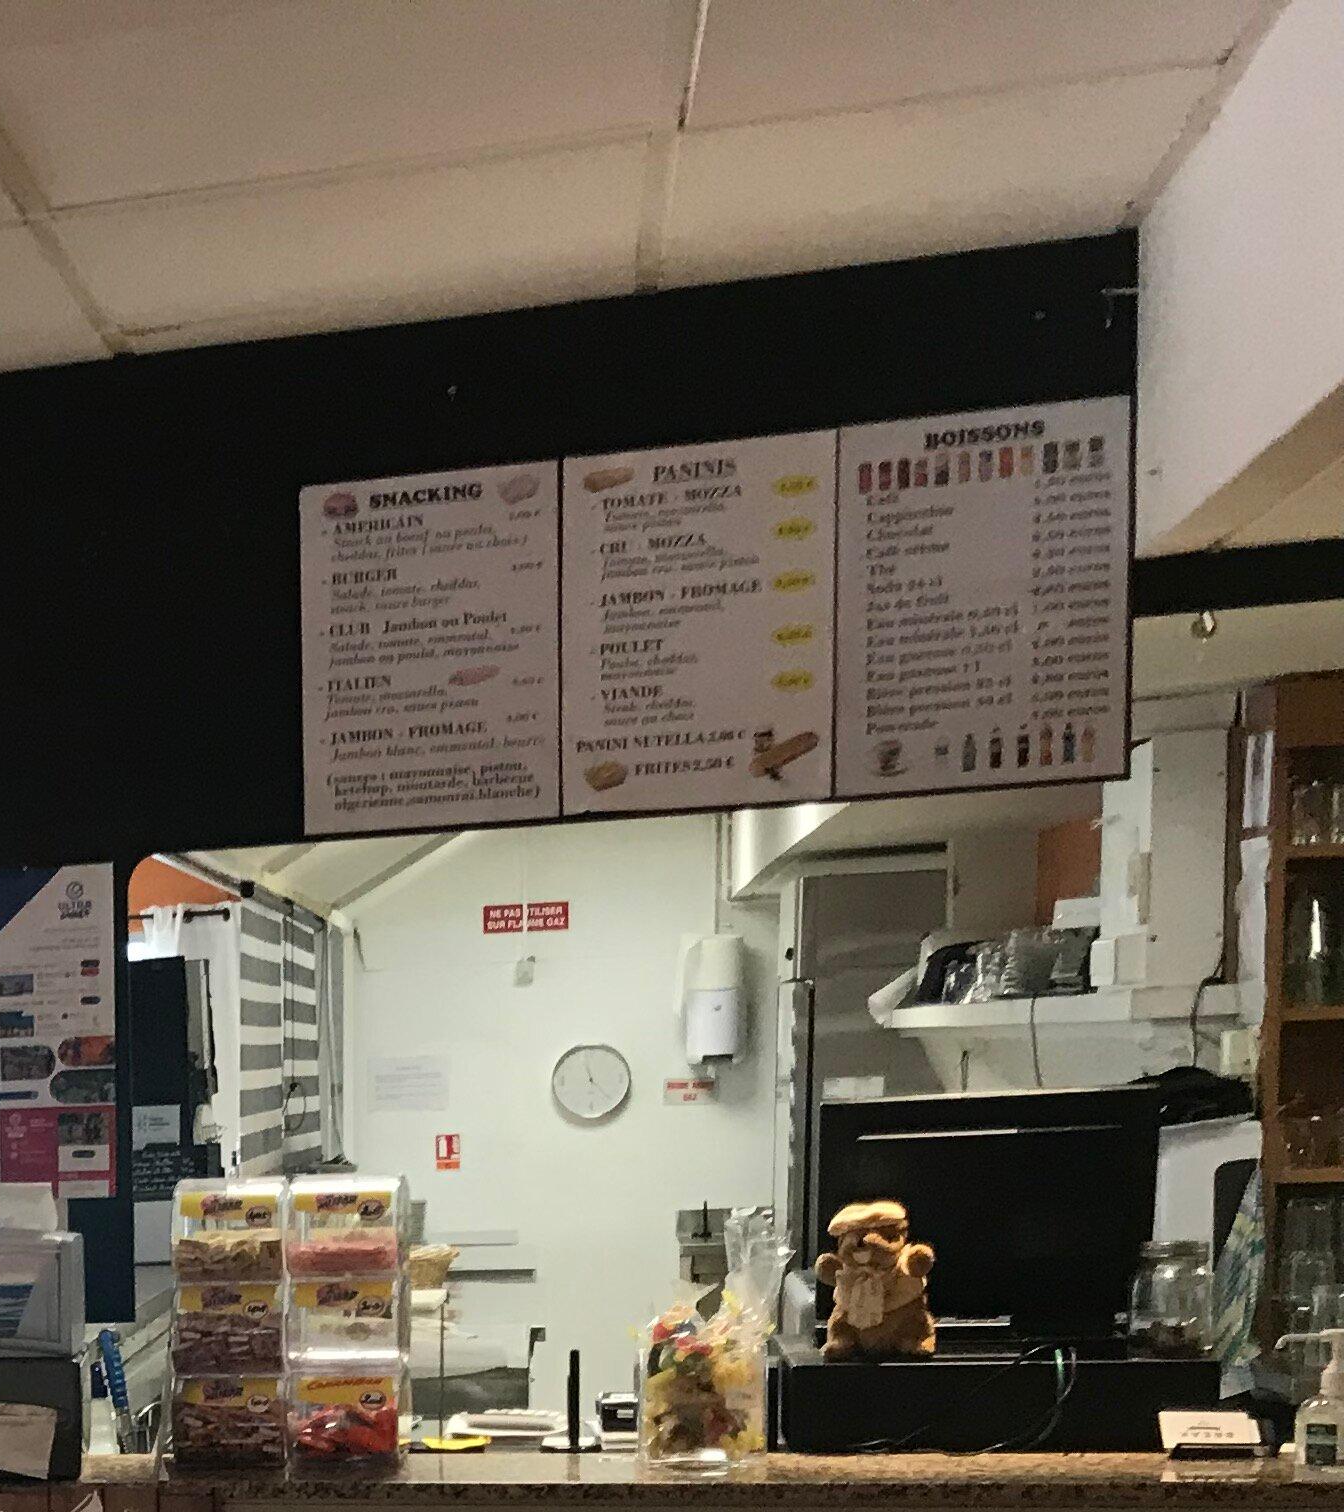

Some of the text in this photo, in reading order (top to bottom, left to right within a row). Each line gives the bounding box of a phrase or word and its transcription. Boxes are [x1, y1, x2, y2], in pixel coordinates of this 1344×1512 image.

[924, 419, 1045, 449] BOISSONS
[369, 483, 482, 509] SNACKING
[599, 637, 663, 655] POULET
[600, 684, 663, 701] VIANDE
[330, 720, 487, 745] JAMBON FROMAGE
[489, 906, 563, 919] NE PAS TILISER
[487, 920, 506, 930] SUR
[546, 917, 566, 927] GAZ
